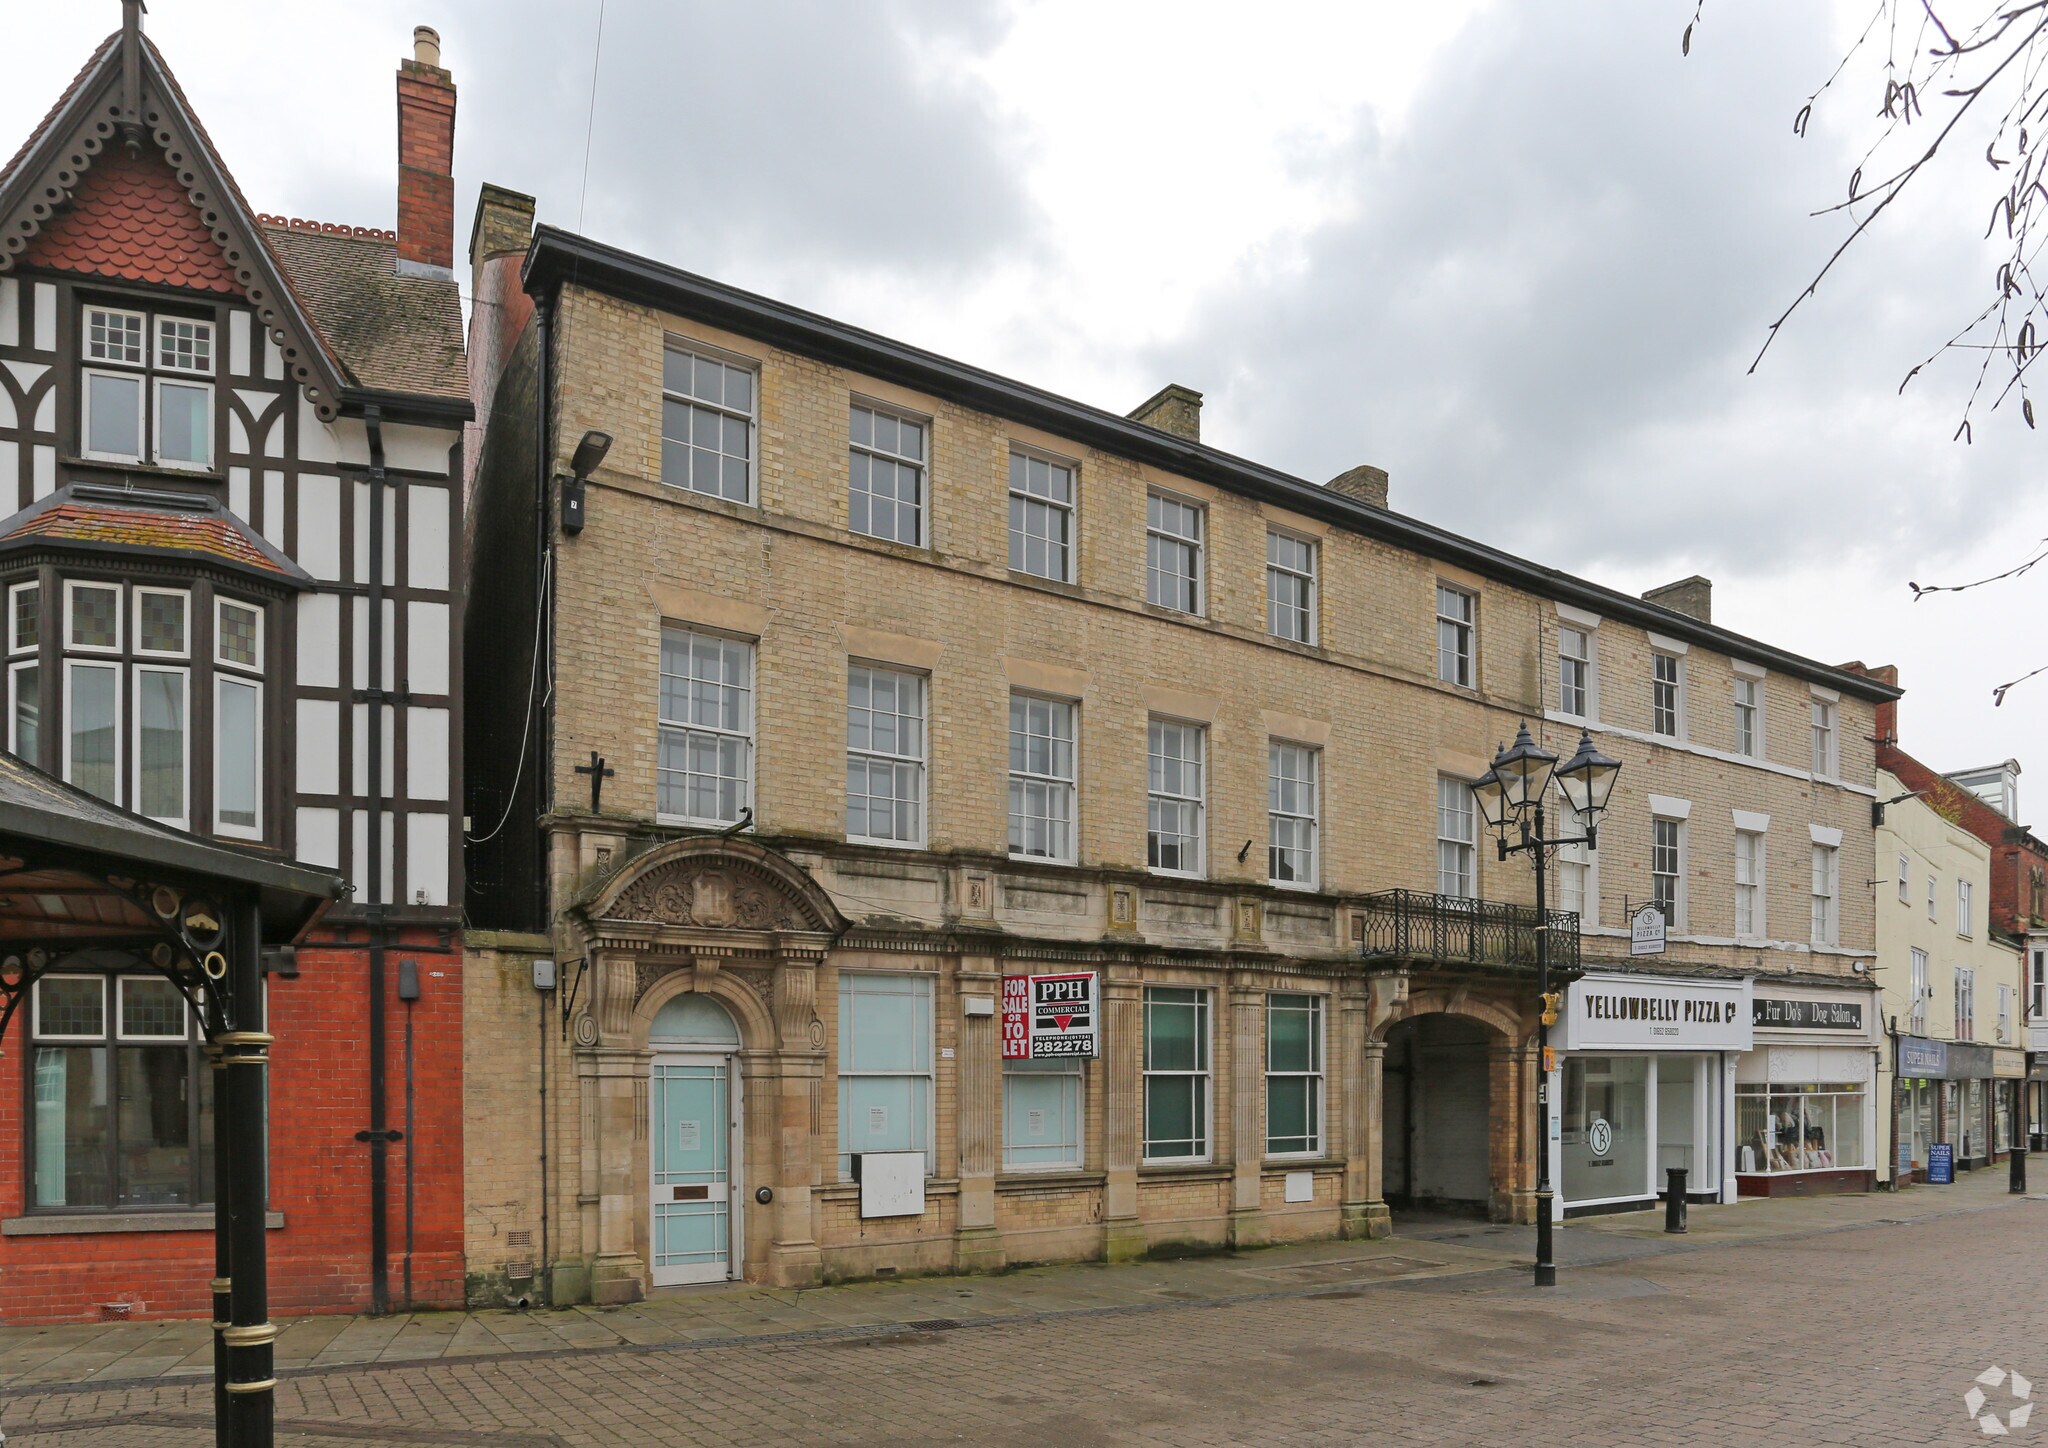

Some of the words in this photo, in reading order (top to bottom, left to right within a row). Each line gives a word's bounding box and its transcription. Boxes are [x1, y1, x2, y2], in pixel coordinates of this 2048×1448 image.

[1004, 979, 1026, 996] FOR
[1041, 981, 1083, 1000] PPH
[1002, 996, 1028, 1014] SALE
[1038, 1005, 1088, 1015] COMMERCIAL
[1585, 995, 1679, 1021] YELLOWBELLY
[1684, 1000, 1720, 1023] PIZZA
[1766, 1000, 1780, 1020] Fur
[1785, 1001, 1802, 1021] Do's
[1812, 1003, 1828, 1024] Dog
[1831, 1003, 1851, 1023] Salon
[1008, 1014, 1021, 1022] OR
[1004, 1022, 1024, 1039] TO
[1002, 1039, 1027, 1056] LET
[1034, 1040, 1092, 1053] 282278
[1907, 1050, 1924, 1065] SUPER
[1925, 1053, 1939, 1066] NAILS
